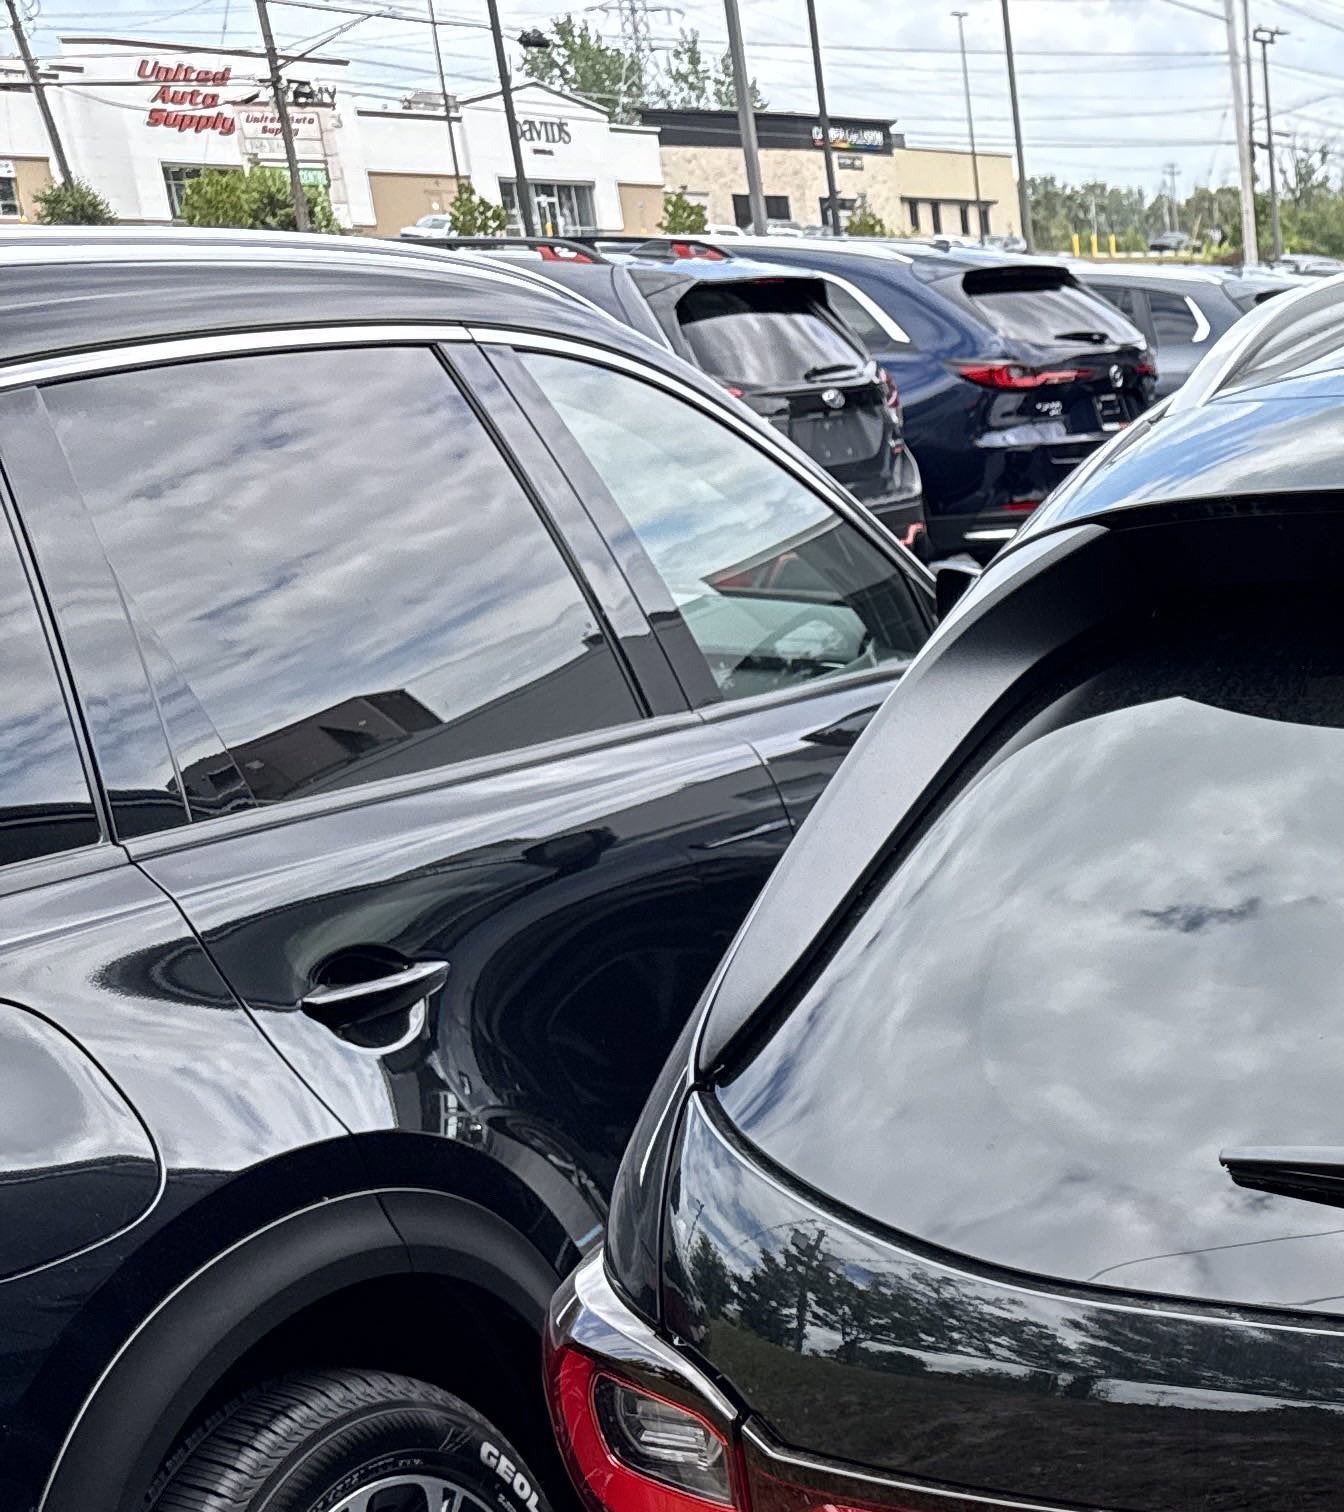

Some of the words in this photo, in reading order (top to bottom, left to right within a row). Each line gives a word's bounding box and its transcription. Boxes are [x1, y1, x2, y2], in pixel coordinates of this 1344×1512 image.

[150, 85, 219, 107] Auto
[146, 108, 235, 136] Supply
[245, 112, 283, 124] Unite
[261, 125, 300, 137] Supy
